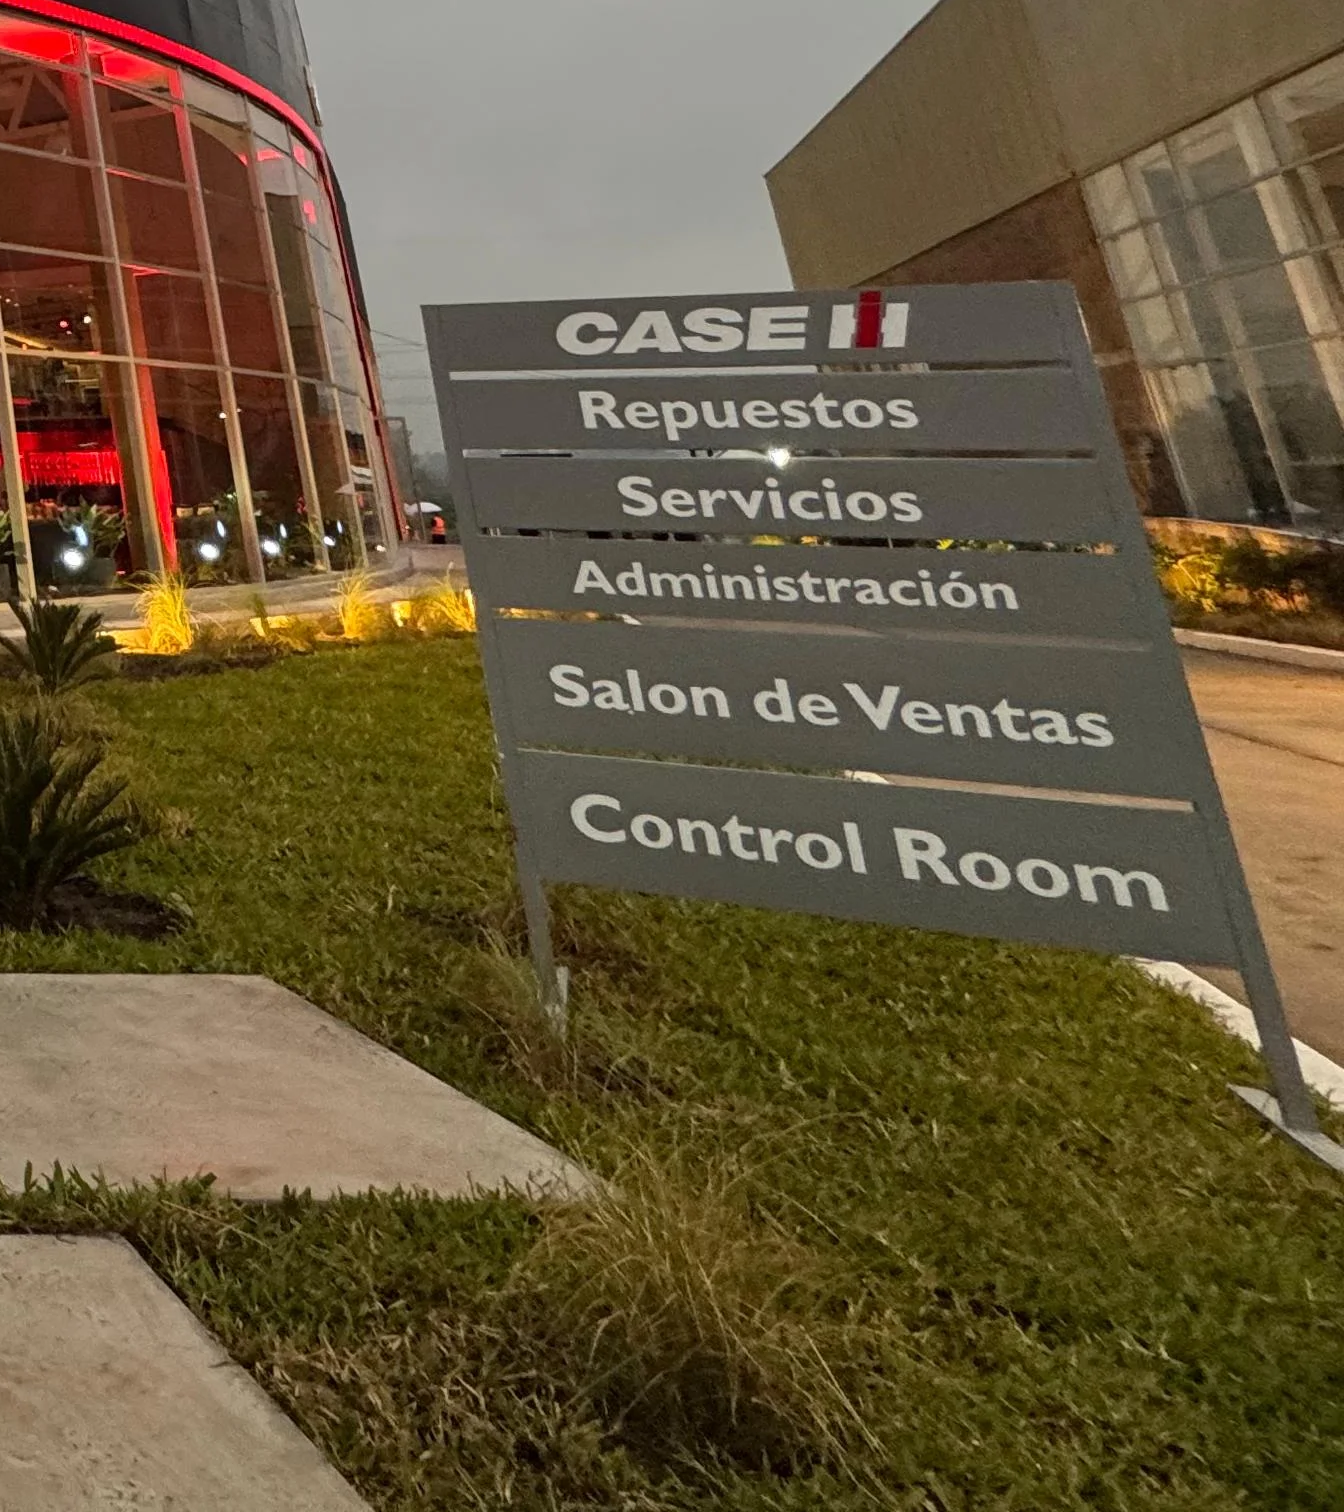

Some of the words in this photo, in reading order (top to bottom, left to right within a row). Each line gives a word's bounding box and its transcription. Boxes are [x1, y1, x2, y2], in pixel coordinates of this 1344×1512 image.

[555, 306, 809, 356] CASE
[579, 390, 919, 441] Repuestos
[617, 475, 922, 524] Servicios
[573, 559, 1019, 611] Administración
[549, 664, 731, 718] Salon
[753, 677, 839, 727] de
[842, 682, 1115, 749] Ventas
[570, 794, 868, 875] Control
[893, 828, 1171, 913] Room
